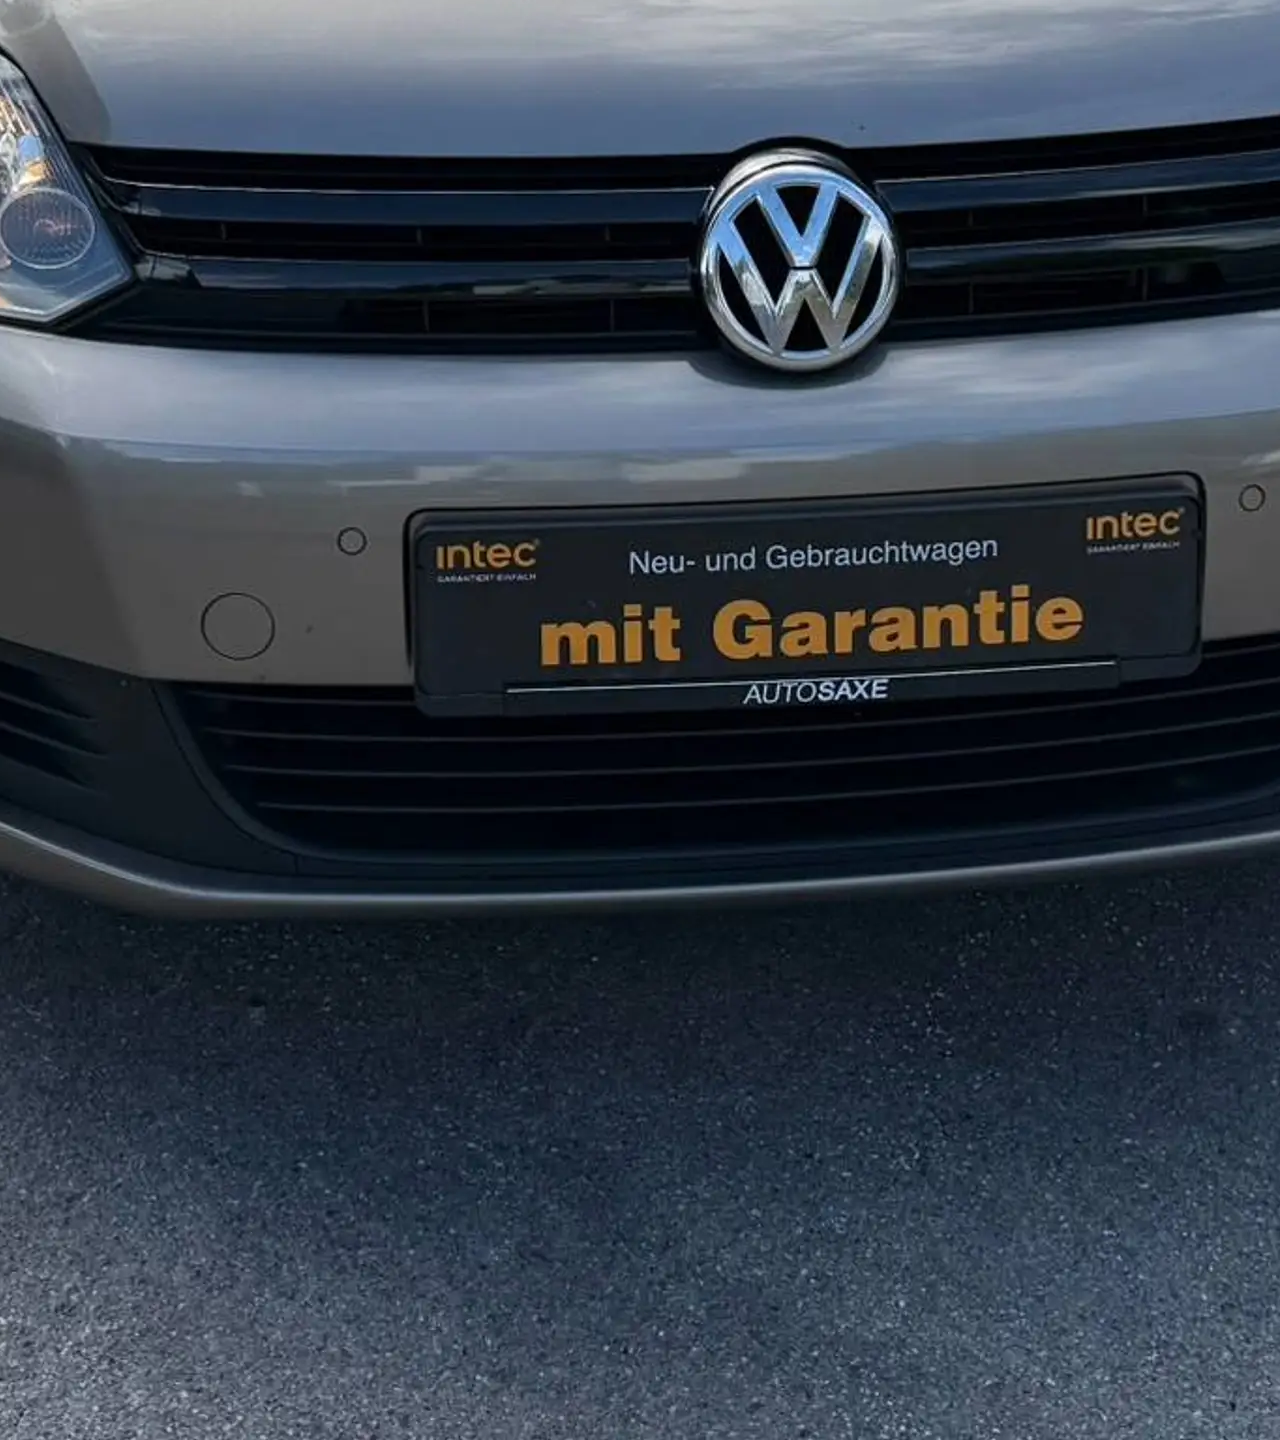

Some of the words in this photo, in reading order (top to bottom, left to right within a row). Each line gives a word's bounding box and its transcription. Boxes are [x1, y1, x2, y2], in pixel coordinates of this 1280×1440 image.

[1086, 510, 1181, 540] intec
[436, 540, 537, 570] intec
[629, 550, 696, 575] Neu-
[706, 546, 757, 572] und
[765, 539, 999, 570] Gebrauchtwagen
[539, 603, 681, 666] mit
[712, 585, 1084, 660] Garantie
[743, 678, 890, 705] AUTOSAXE
